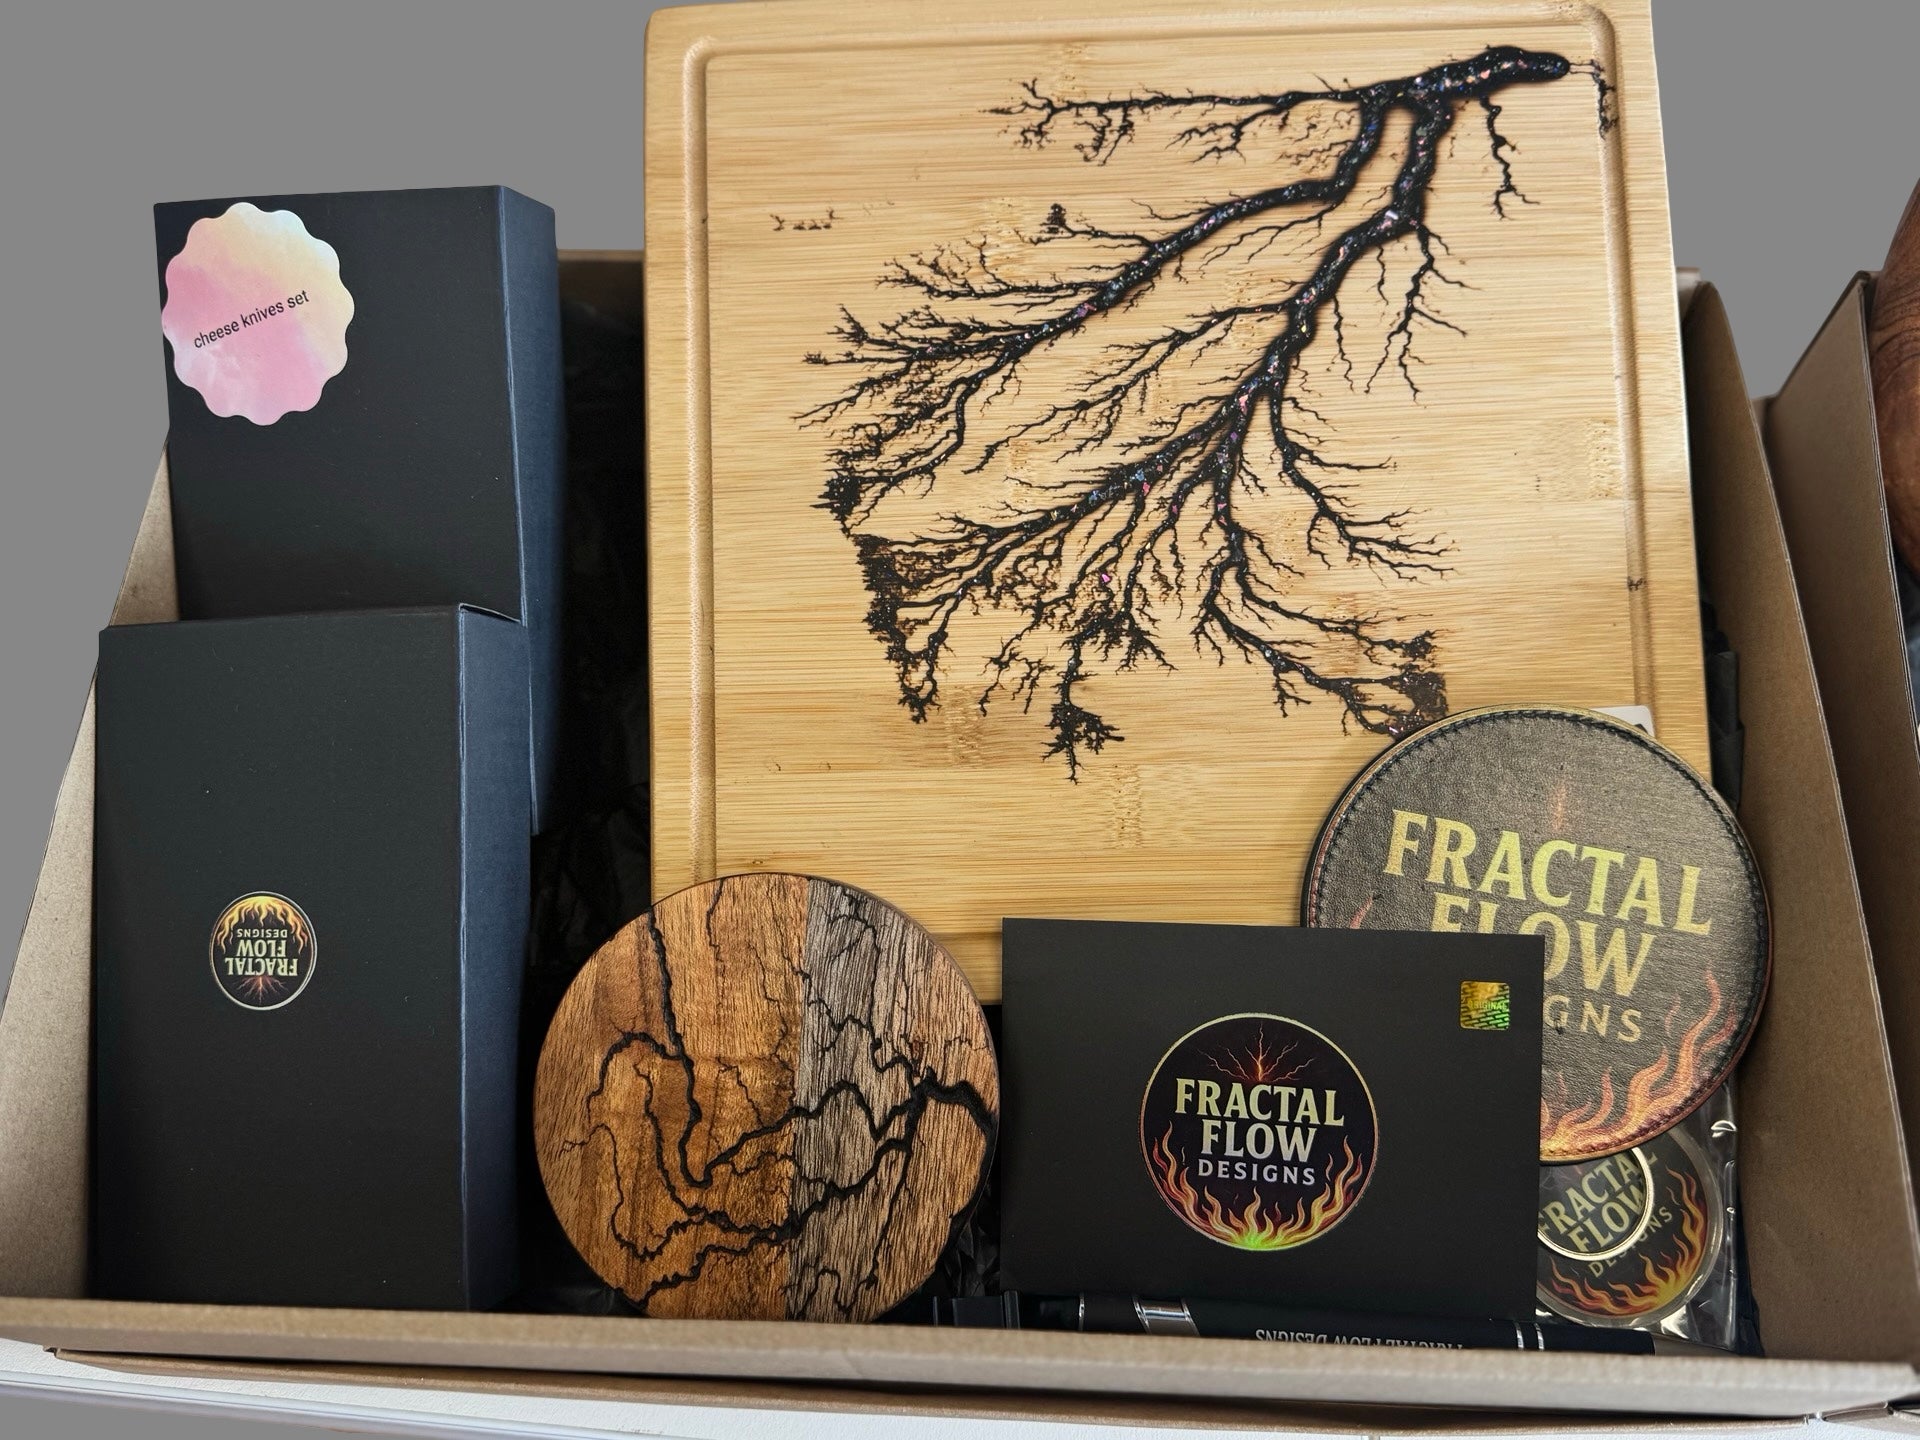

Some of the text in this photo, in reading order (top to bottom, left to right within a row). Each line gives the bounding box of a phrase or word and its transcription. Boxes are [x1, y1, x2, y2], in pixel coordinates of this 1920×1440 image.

[194, 289, 309, 348] cheese knives set
[1383, 809, 1713, 936] FRACTAL
[236, 928, 288, 938] DESIGNS
[236, 939, 287, 958] FLOW
[225, 957, 298, 977] FRACTAL
[1174, 1077, 1345, 1127] FRACTAL
[1200, 1118, 1318, 1163] FLOW
[1197, 1158, 1316, 1186] DESIGNS
